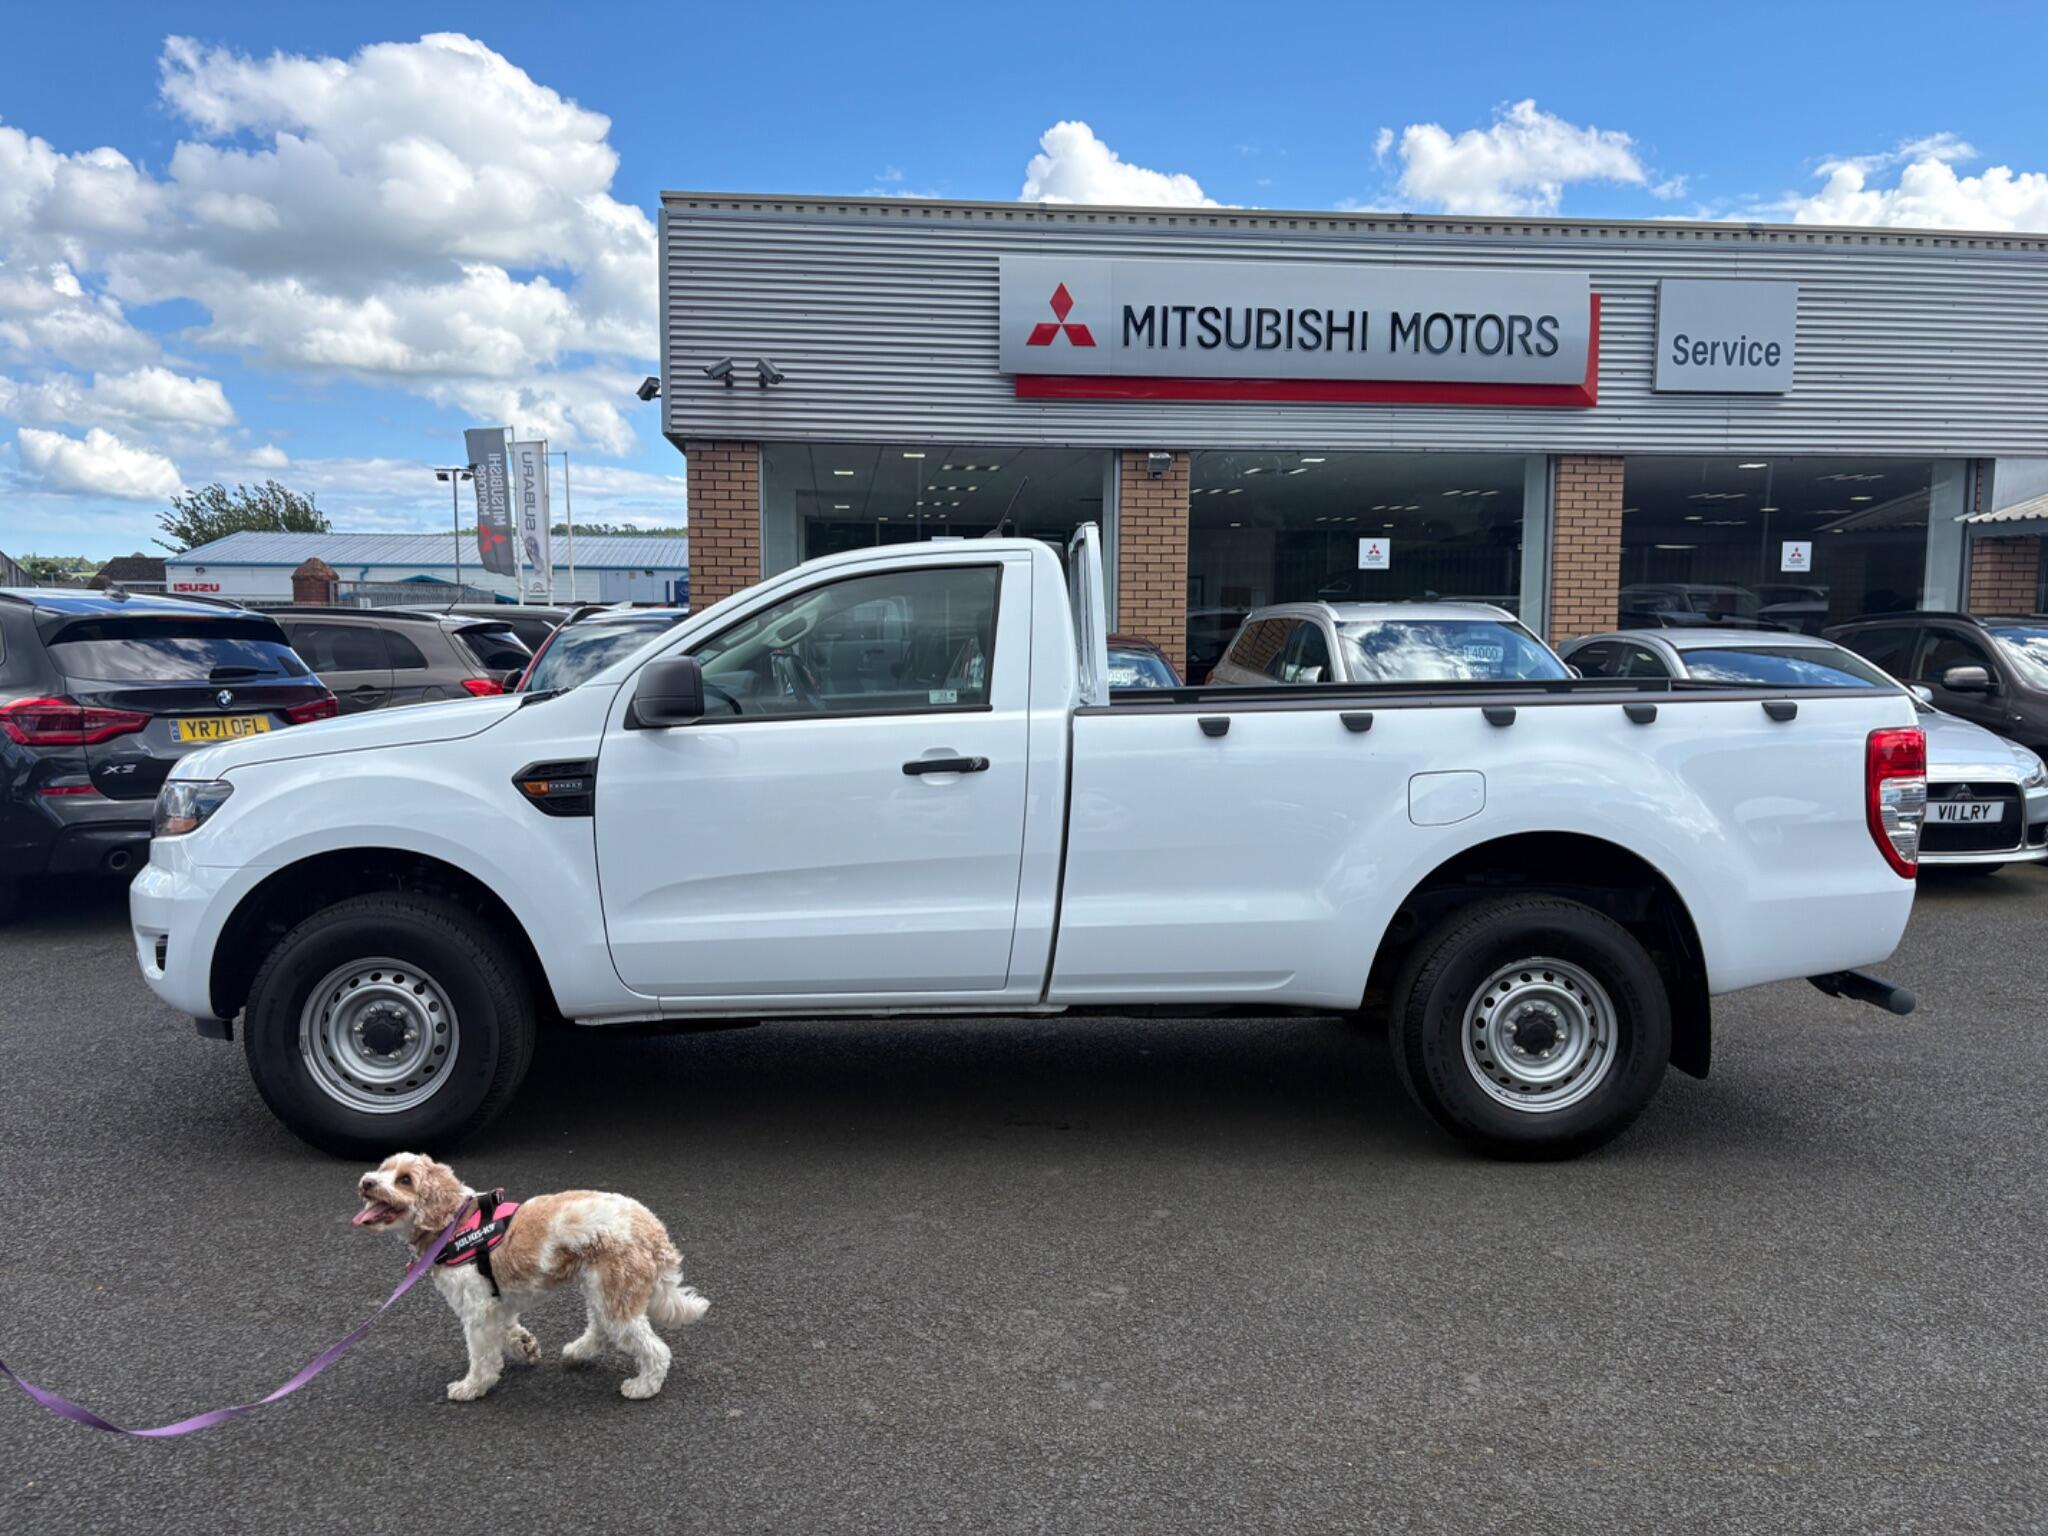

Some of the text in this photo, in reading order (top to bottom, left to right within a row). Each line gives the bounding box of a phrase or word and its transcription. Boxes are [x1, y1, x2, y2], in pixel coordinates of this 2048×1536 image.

[1123, 305, 1560, 357] MITSUBISHI MOTORS
[1672, 333, 1781, 367] Service
[173, 583, 220, 592] ISUZU
[186, 717, 265, 738] YR71 OFL
[101, 764, 137, 775] X3
